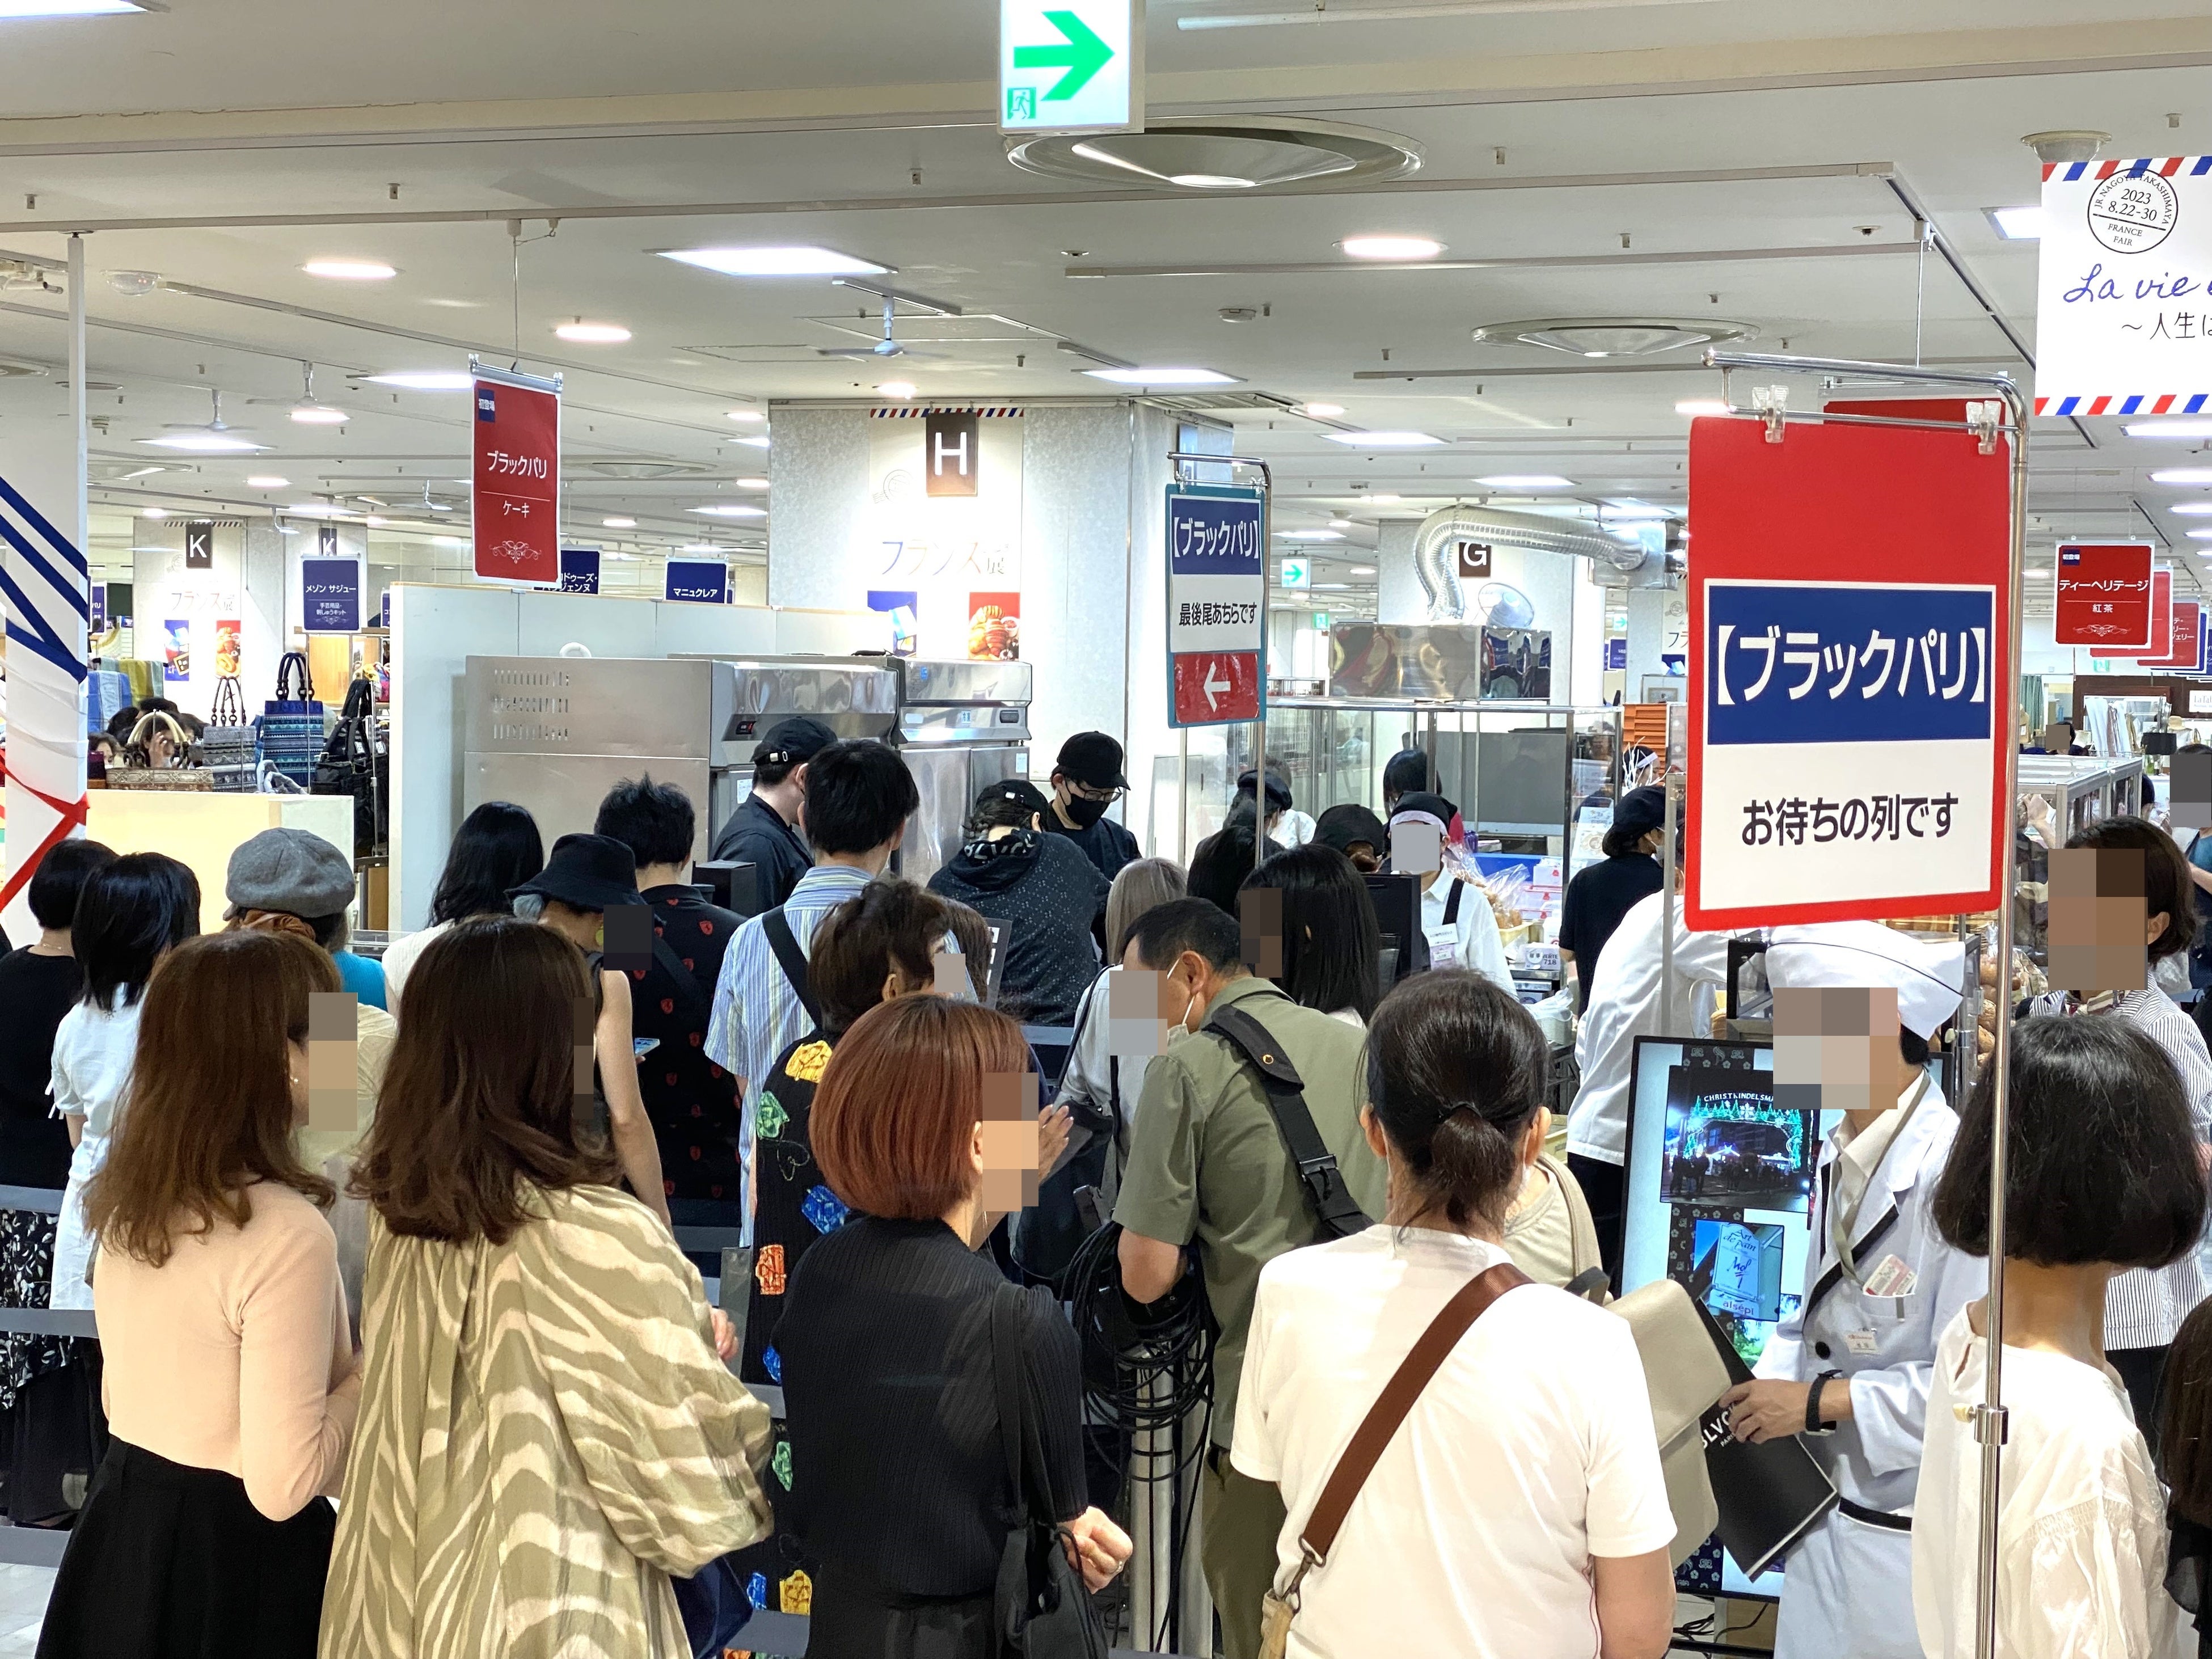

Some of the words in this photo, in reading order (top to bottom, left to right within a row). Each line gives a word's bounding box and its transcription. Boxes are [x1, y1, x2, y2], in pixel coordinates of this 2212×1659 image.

[2095, 199, 2104, 208] JR
[2121, 188, 2151, 204] 2023
[2108, 201, 2157, 221] 8.22-30
[2108, 223, 2143, 237] FRANCE
[2113, 236, 2133, 246] FAIR
[2063, 263, 2125, 302] La
[2135, 272, 2201, 299] vie
[934, 432, 968, 476] H
[487, 450, 547, 479] ブラックパリ
[503, 500, 530, 518] ケーキ
[189, 534, 208, 558] K
[322, 537, 335, 556] K
[1174, 517, 1260, 559] 【ブラックパリ】
[1463, 541, 1488, 567] G
[561, 572, 598, 583] ドゥーズ・
[2059, 580, 2149, 591] ティーヘリテージ
[306, 585, 326, 593] メゾン
[328, 585, 357, 593] サジュー
[543, 582, 590, 593] ジェンヌ
[673, 588, 718, 598] マニュクレア
[1179, 601, 1257, 627] 最後尾あちらです
[2092, 604, 2113, 613] 紅茶
[1717, 624, 1986, 705] 【ブラックパリ】
[1741, 792, 1959, 846] お待ちの列です
